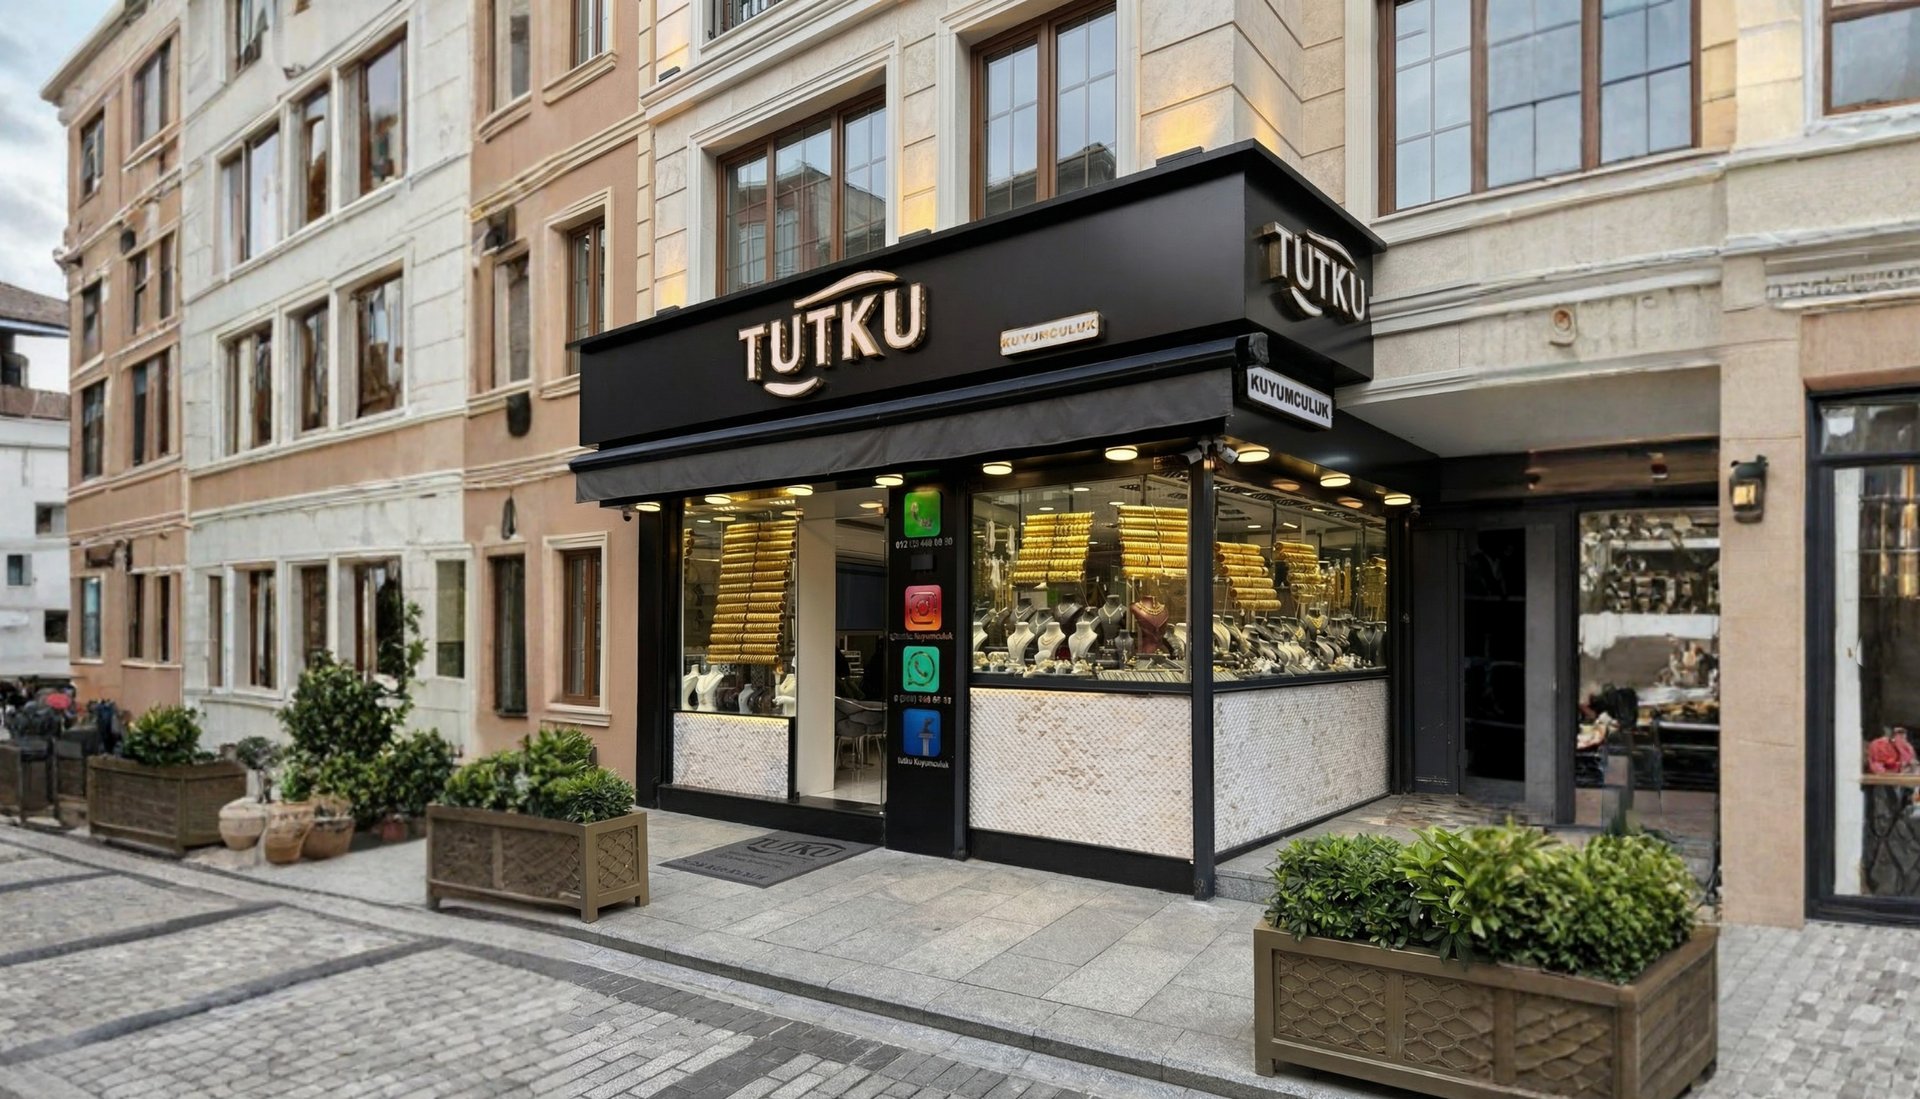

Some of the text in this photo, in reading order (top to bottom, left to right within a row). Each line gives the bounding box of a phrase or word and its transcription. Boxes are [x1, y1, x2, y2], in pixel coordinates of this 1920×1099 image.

[1267, 222, 1365, 320] TUTKU
[738, 283, 924, 381] TUTKU
[1001, 319, 1096, 348] KUYUMCULUK
[1250, 373, 1330, 419] KUYUMCULUK
